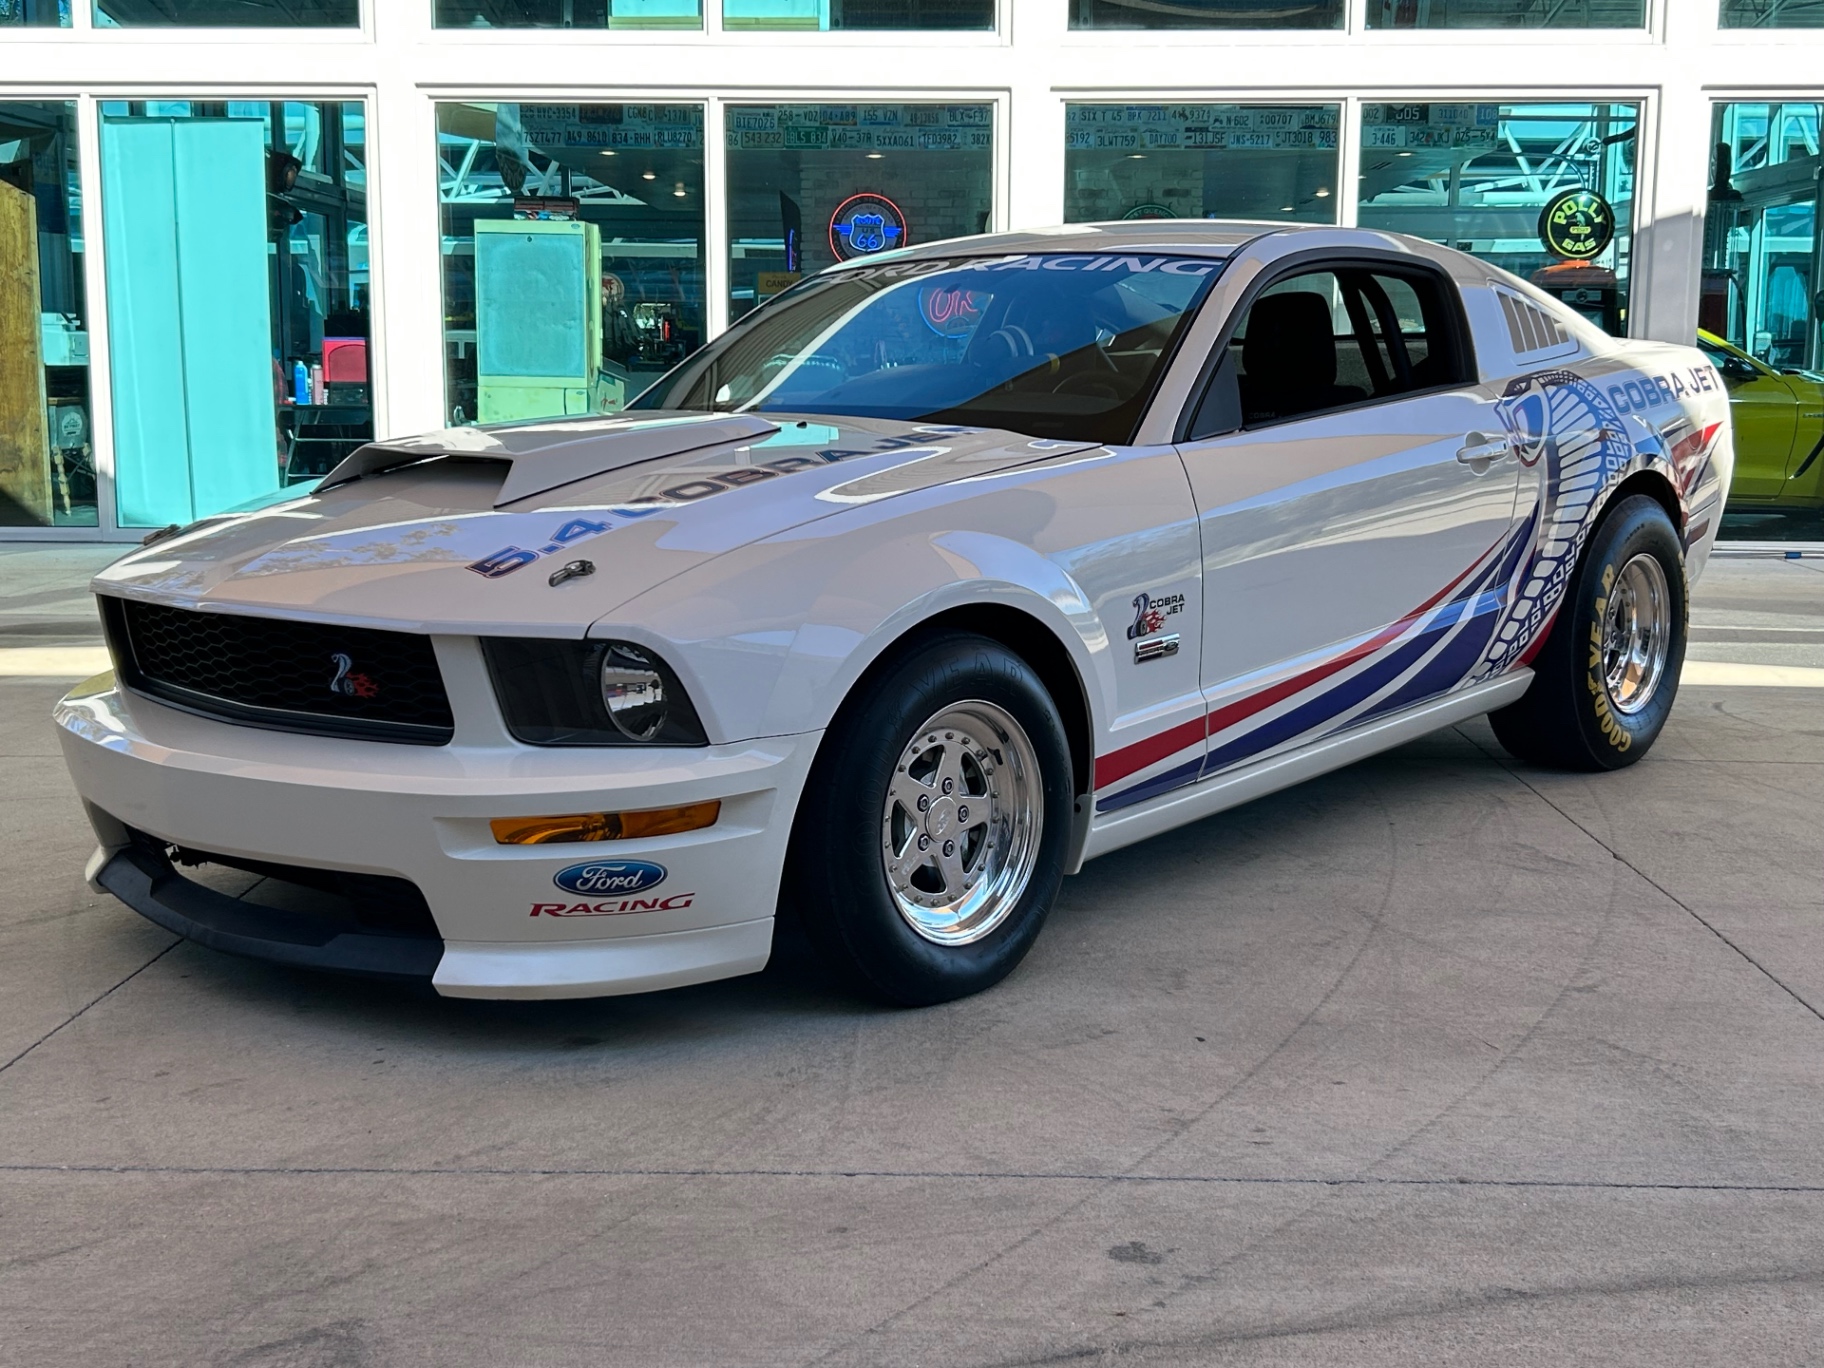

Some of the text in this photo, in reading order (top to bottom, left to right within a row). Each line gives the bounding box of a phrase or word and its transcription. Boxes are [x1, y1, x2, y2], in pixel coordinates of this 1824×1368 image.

[857, 233, 878, 249] 66
[1561, 237, 1596, 252] GAS
[962, 253, 1224, 276] RACING
[1607, 365, 1719, 416] COBRA JET
[465, 516, 612, 579] 5.4
[1149, 593, 1185, 610] COBRA
[1166, 603, 1185, 616] JET
[575, 865, 645, 891] Ford
[529, 892, 696, 918] RACING
